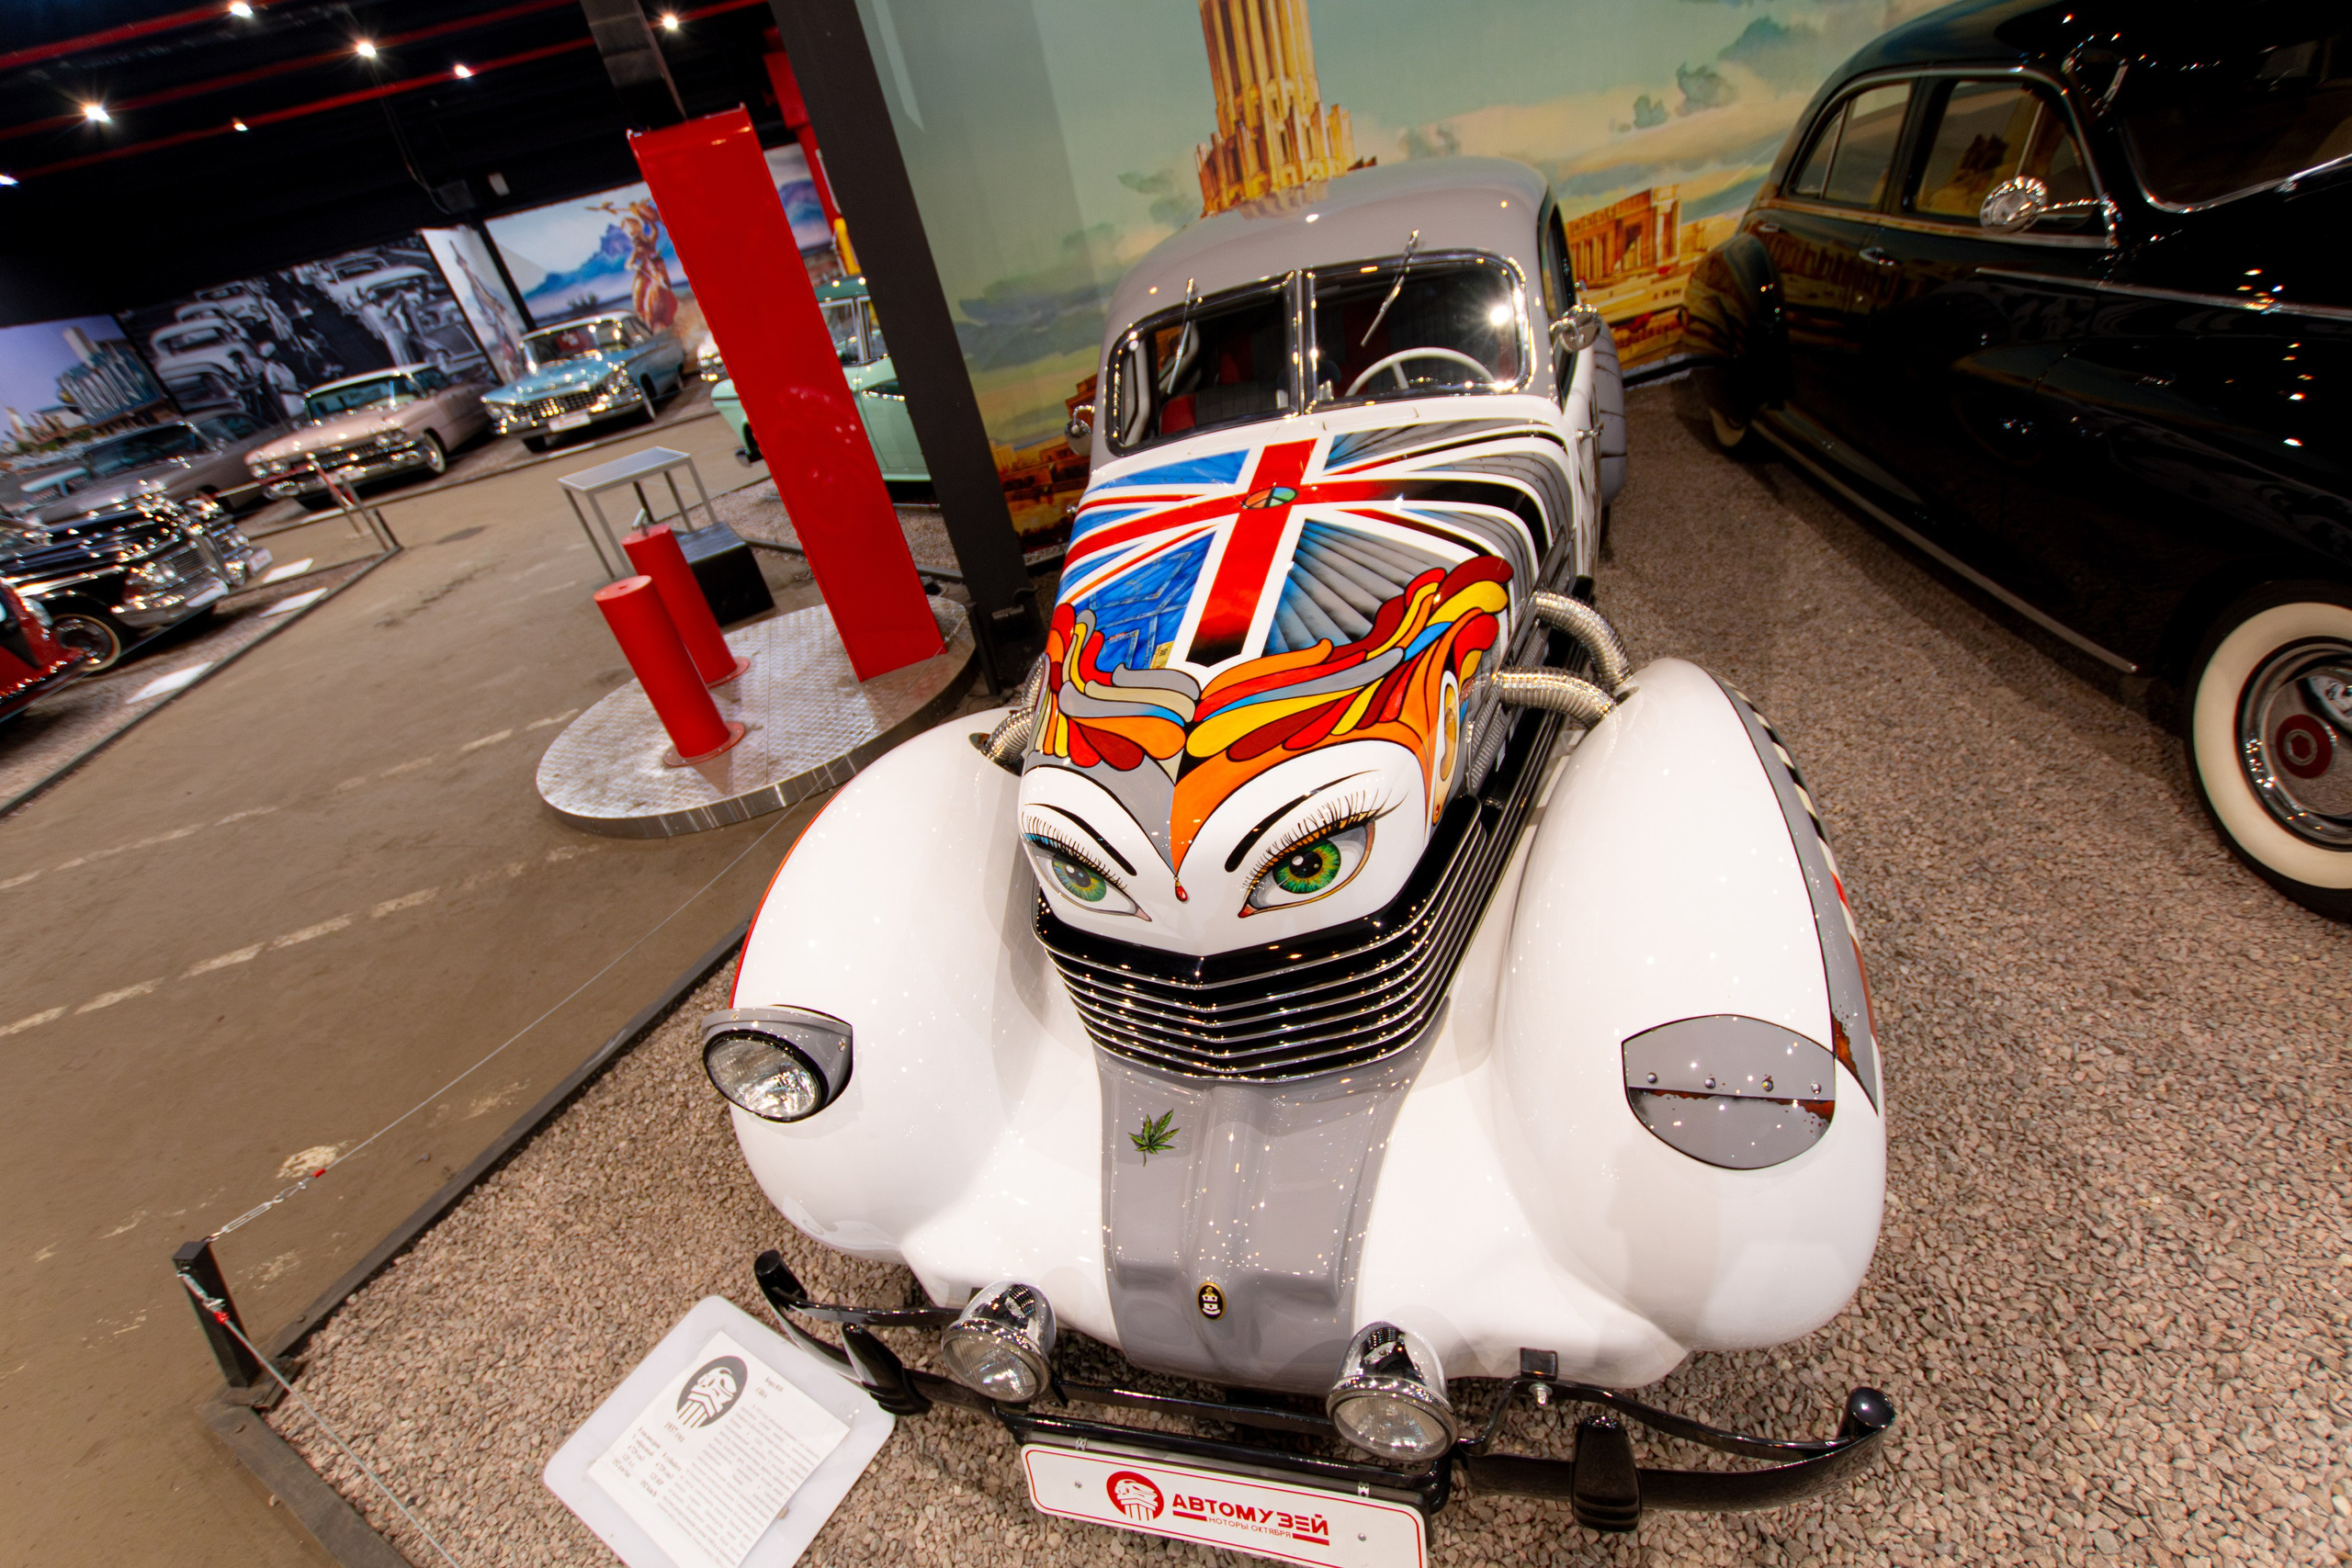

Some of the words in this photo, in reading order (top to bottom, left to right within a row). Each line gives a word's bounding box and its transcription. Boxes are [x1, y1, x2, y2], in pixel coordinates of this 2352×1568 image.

[662, 1420, 679, 1436] 1937
[1172, 1493, 1329, 1536] АВТОМУЗЕЙ
[1209, 1517, 1249, 1530] МОТОРЫ
[1250, 1525, 1291, 1538] ОКТЯБРЯ
